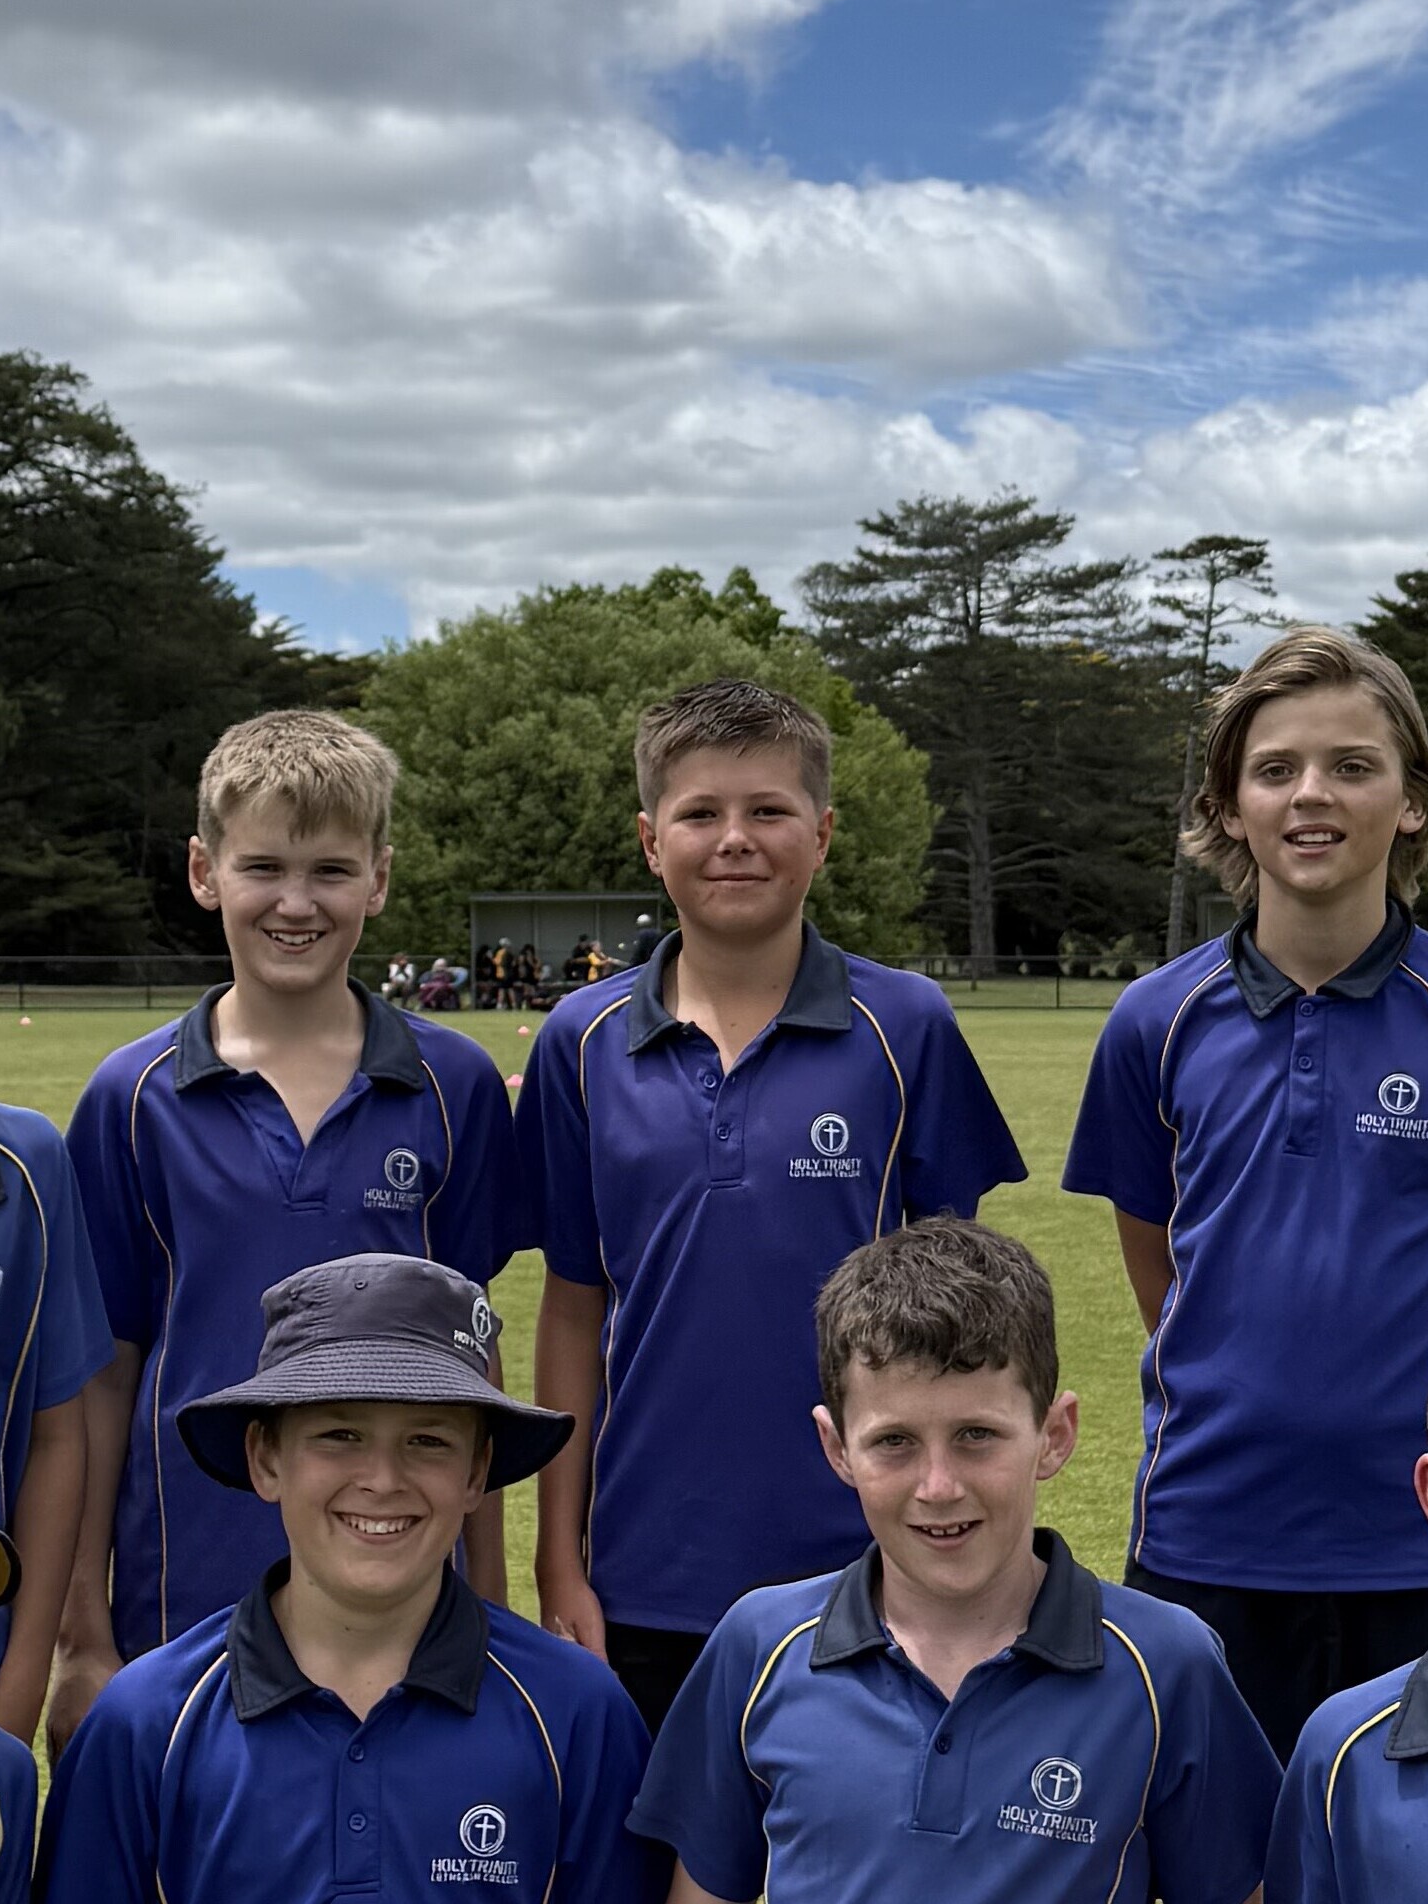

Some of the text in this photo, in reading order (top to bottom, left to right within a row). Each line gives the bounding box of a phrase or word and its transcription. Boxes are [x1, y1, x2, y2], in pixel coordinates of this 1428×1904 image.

[1356, 1113, 1387, 1127] HOLY
[790, 1158, 820, 1170] HOLY
[363, 1188, 392, 1202] HOLY
[1000, 1805, 1098, 1835] HOLY TRINITY
[431, 1858, 518, 1875] HOLY TRINIT
